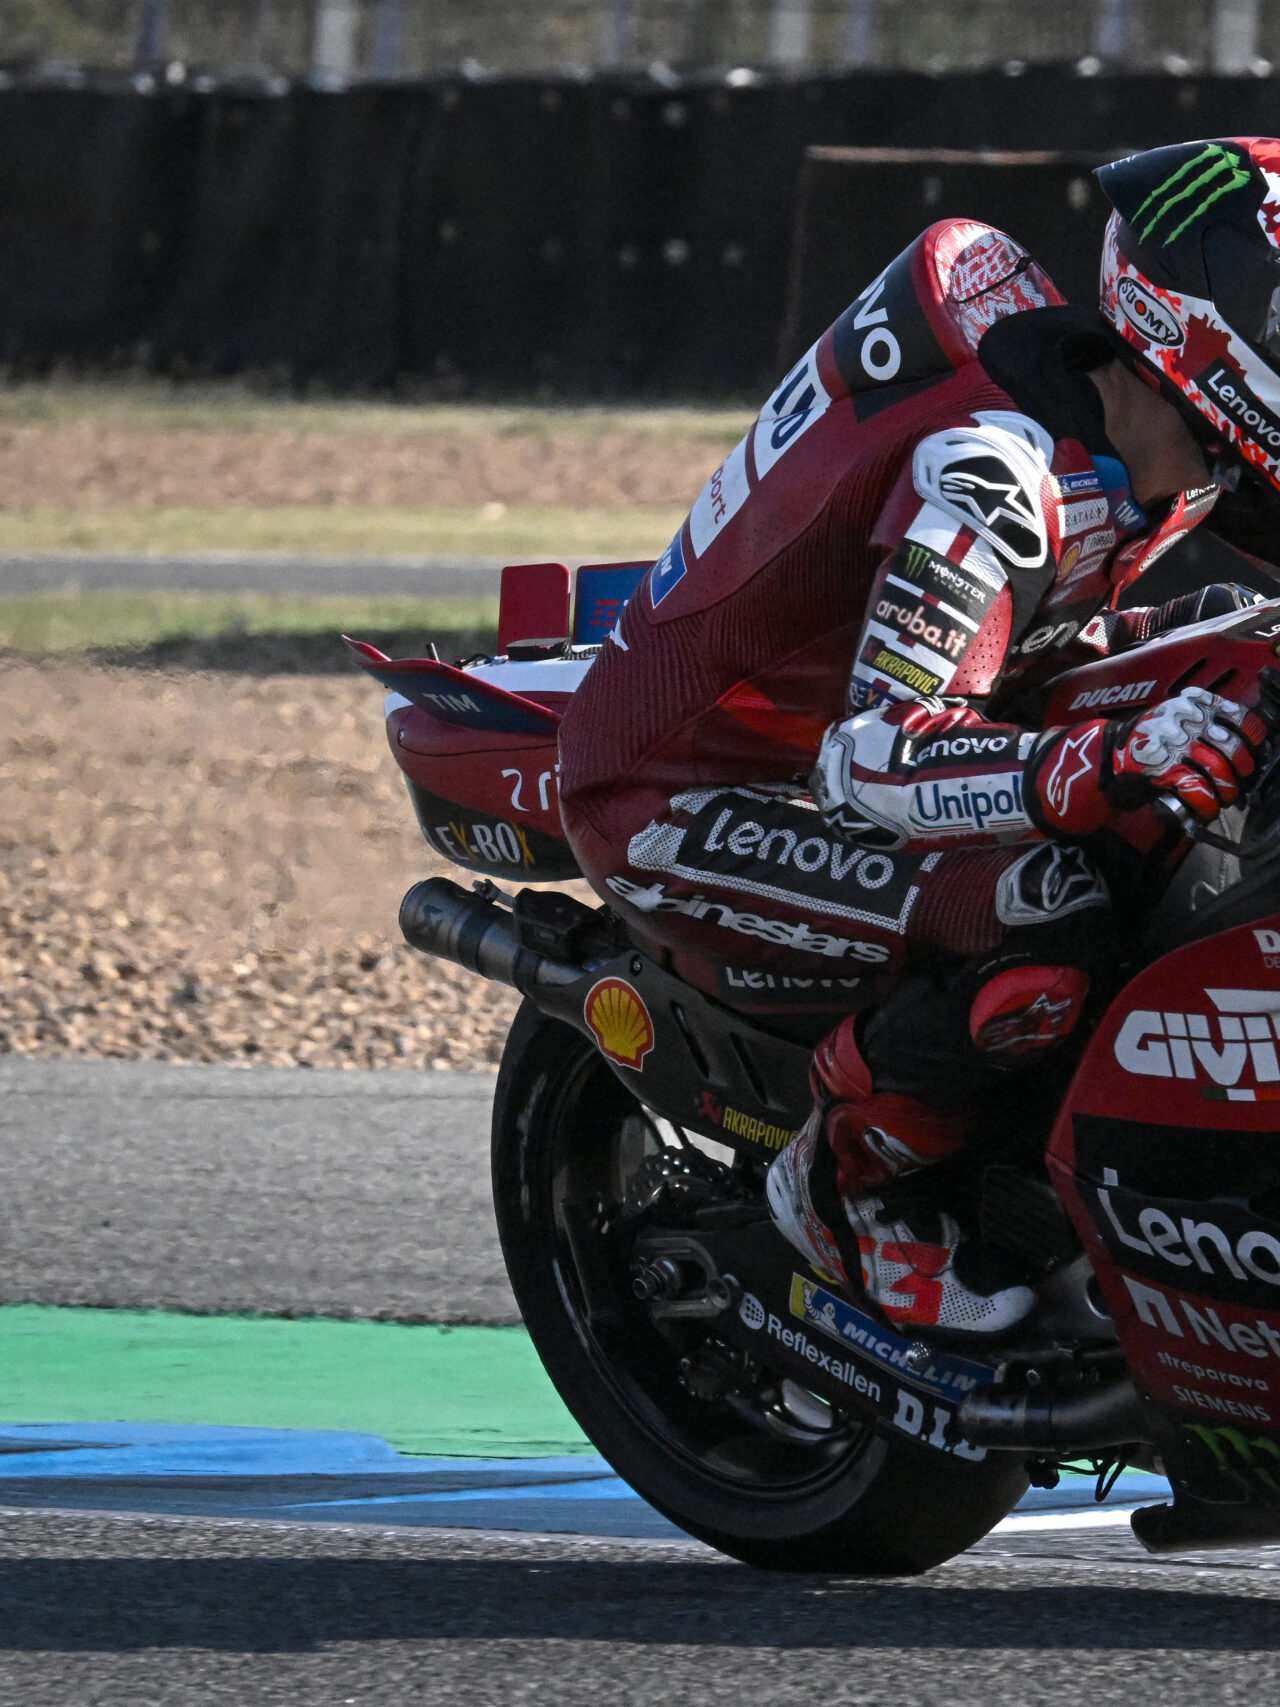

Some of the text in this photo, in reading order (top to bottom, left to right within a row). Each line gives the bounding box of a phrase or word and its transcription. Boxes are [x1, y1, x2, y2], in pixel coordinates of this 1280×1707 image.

[1121, 279, 1177, 344] SUOMY
[1114, 500, 1140, 527] TIM
[928, 560, 986, 603] MONSTER
[876, 599, 967, 658] aruba.it
[422, 692, 482, 713] TIM
[1068, 679, 1158, 711] DUCATI
[901, 735, 1008, 767] Lenovo
[914, 774, 1024, 829] Unipol
[422, 821, 537, 872] EX-BOX
[703, 807, 894, 890] Lenovo
[767, 1313, 882, 1402] Reflexallen
[843, 1321, 978, 1392] MICHLIN
[1157, 1351, 1270, 1392] streparava
[1172, 1384, 1272, 1422] SIEMENS
